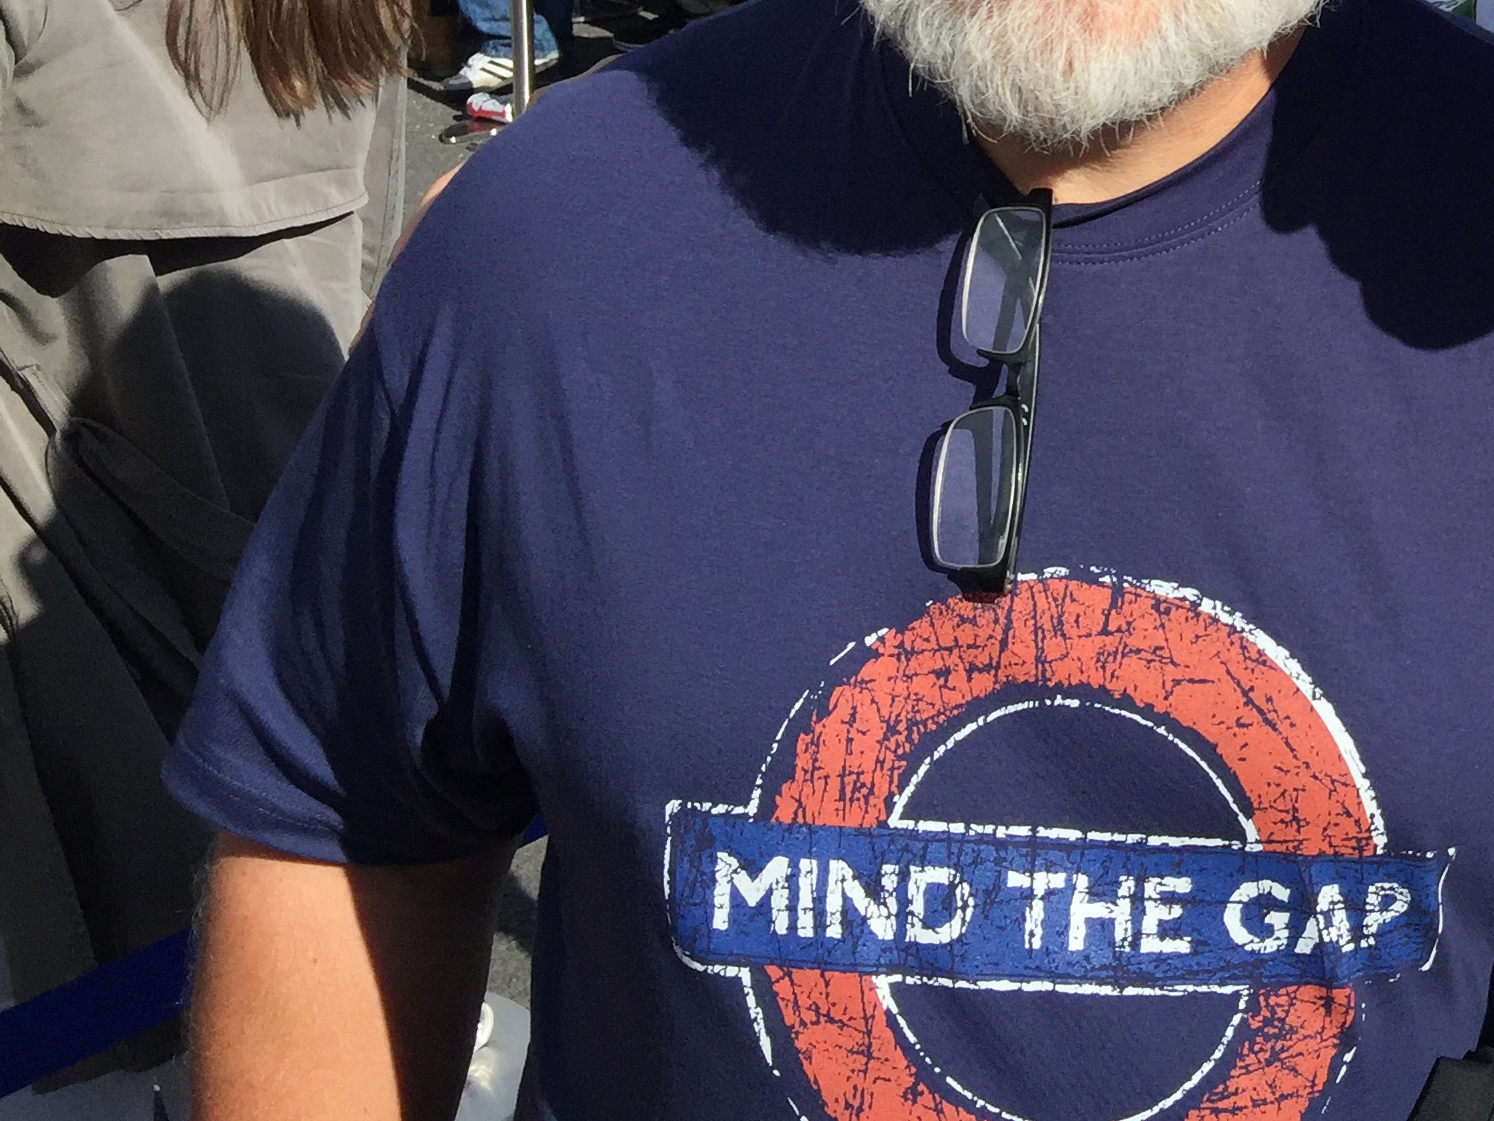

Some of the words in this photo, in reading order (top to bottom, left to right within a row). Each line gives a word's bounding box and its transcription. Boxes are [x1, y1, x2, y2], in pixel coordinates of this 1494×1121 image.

[712, 850, 974, 946] MIND
[1006, 868, 1192, 956] THE
[1223, 878, 1412, 956] GAP
